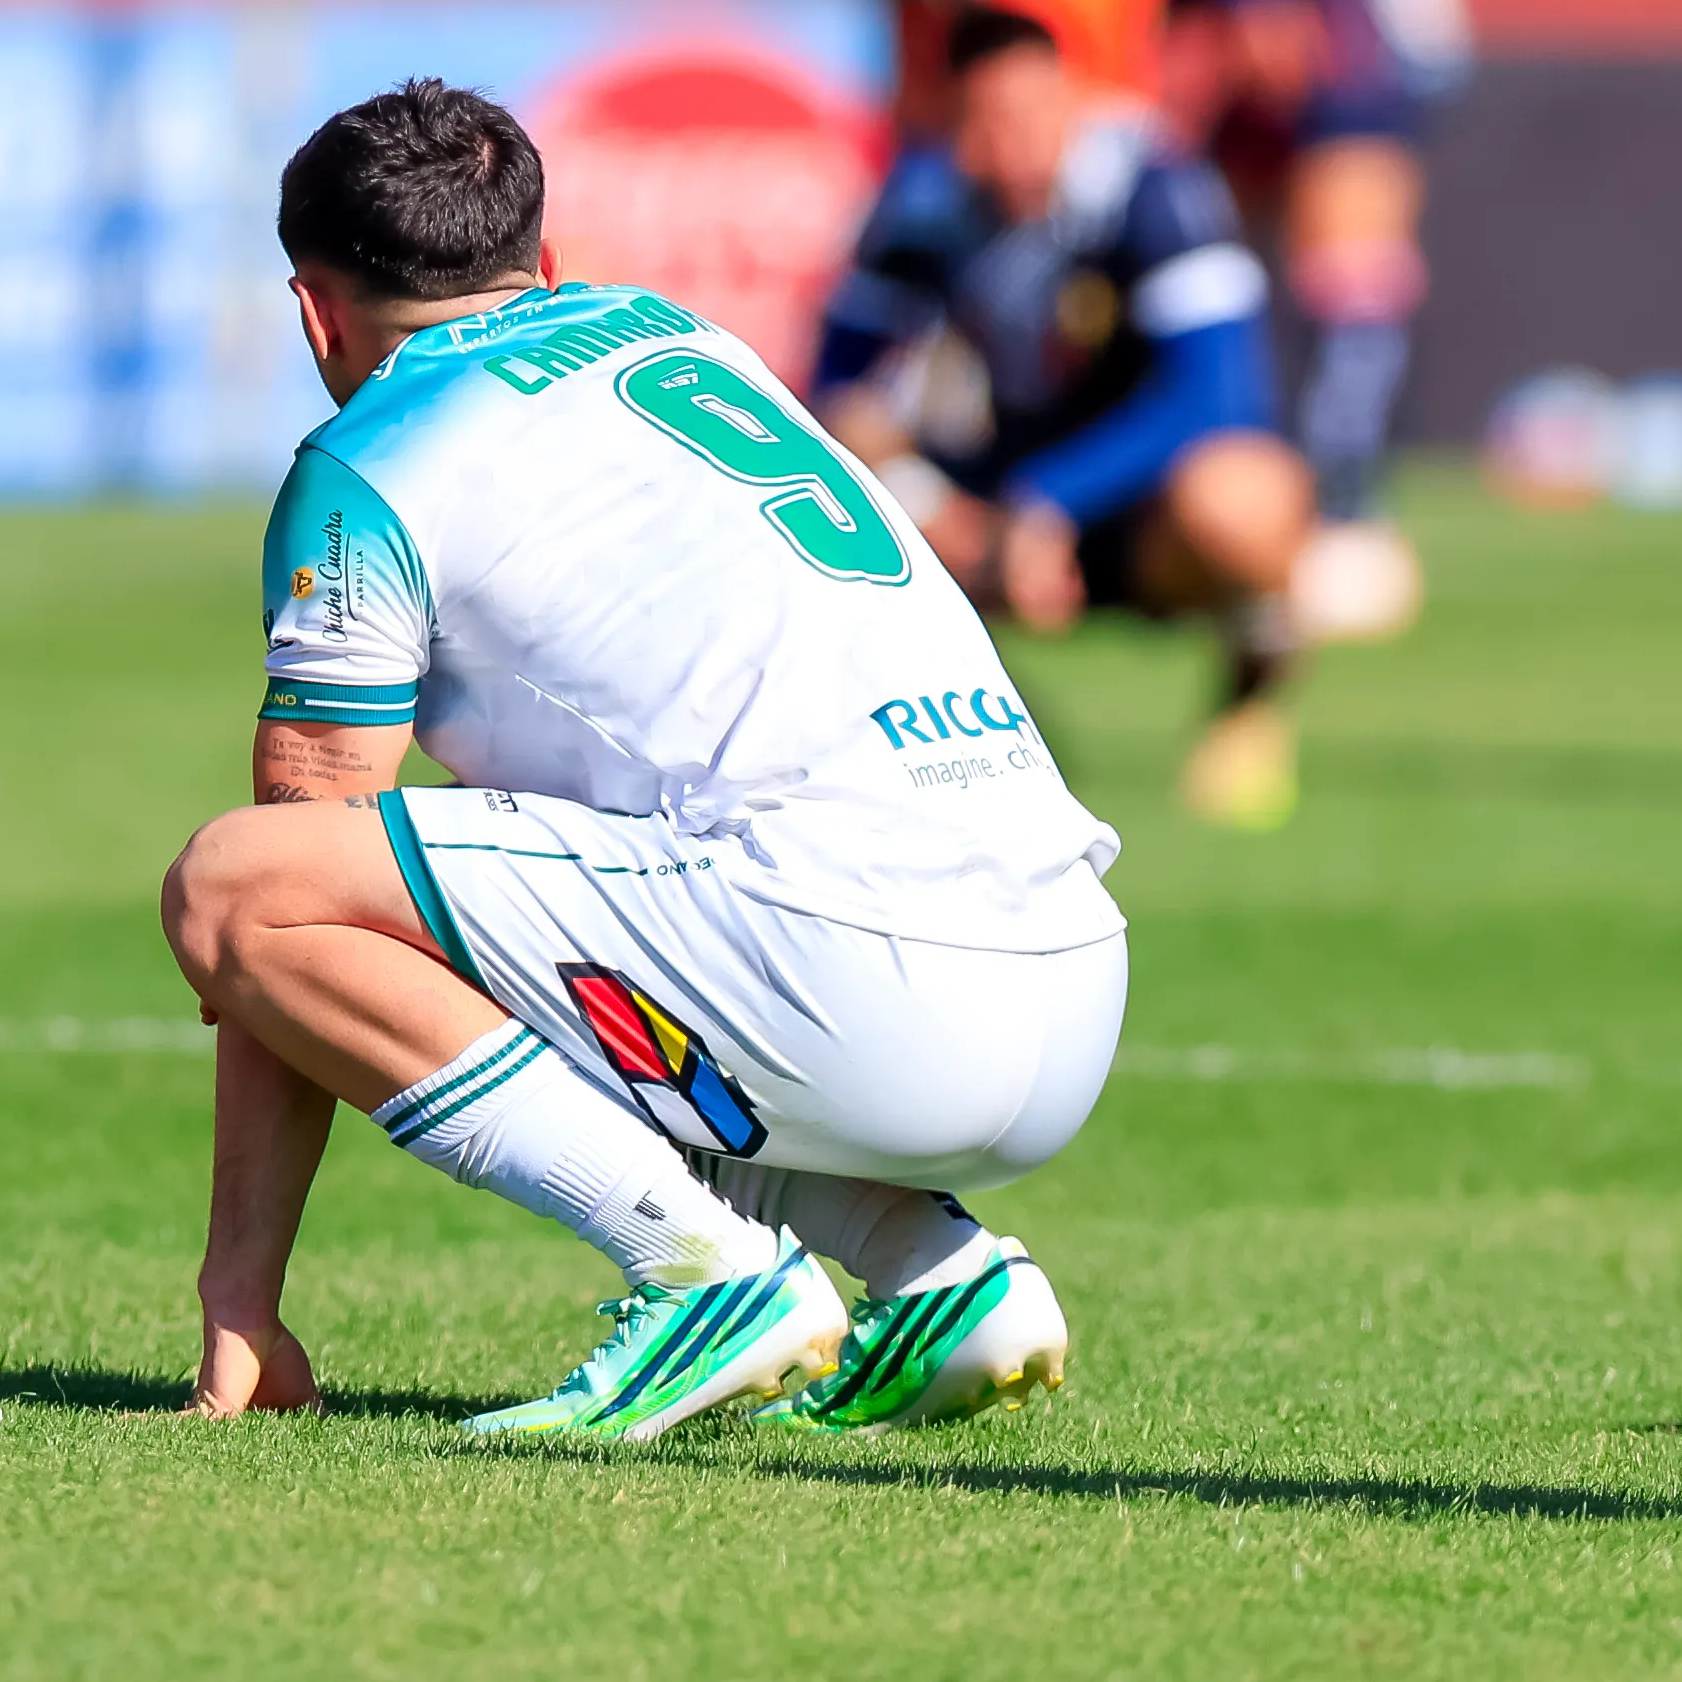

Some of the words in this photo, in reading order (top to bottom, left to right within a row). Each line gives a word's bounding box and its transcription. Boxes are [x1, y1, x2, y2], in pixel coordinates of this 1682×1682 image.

[613, 346, 913, 587] 9
[318, 509, 344, 582] Cuadra
[356, 549, 365, 609] PARRILLA
[322, 585, 349, 643] Chiche
